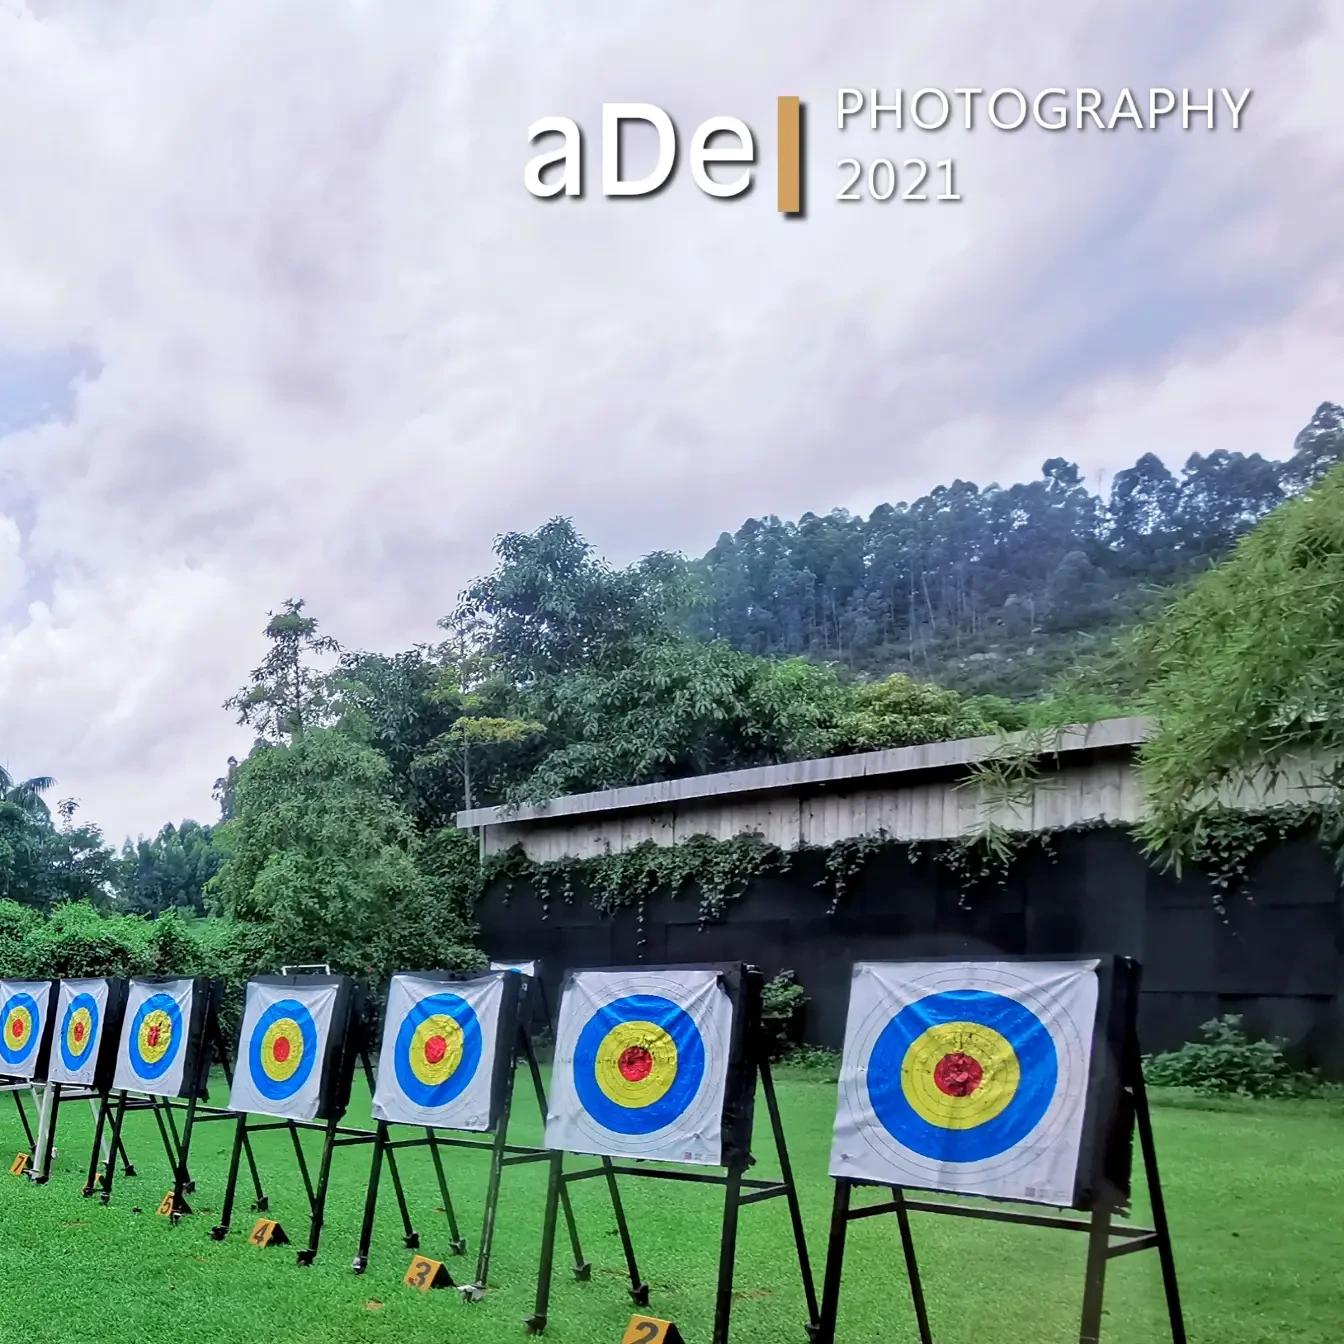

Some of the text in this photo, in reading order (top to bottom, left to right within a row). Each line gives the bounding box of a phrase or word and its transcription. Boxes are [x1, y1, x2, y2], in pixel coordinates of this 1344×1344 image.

[13, 1155, 26, 1172] 7
[253, 1222, 270, 1244] 4
[409, 1261, 432, 1287] 3
